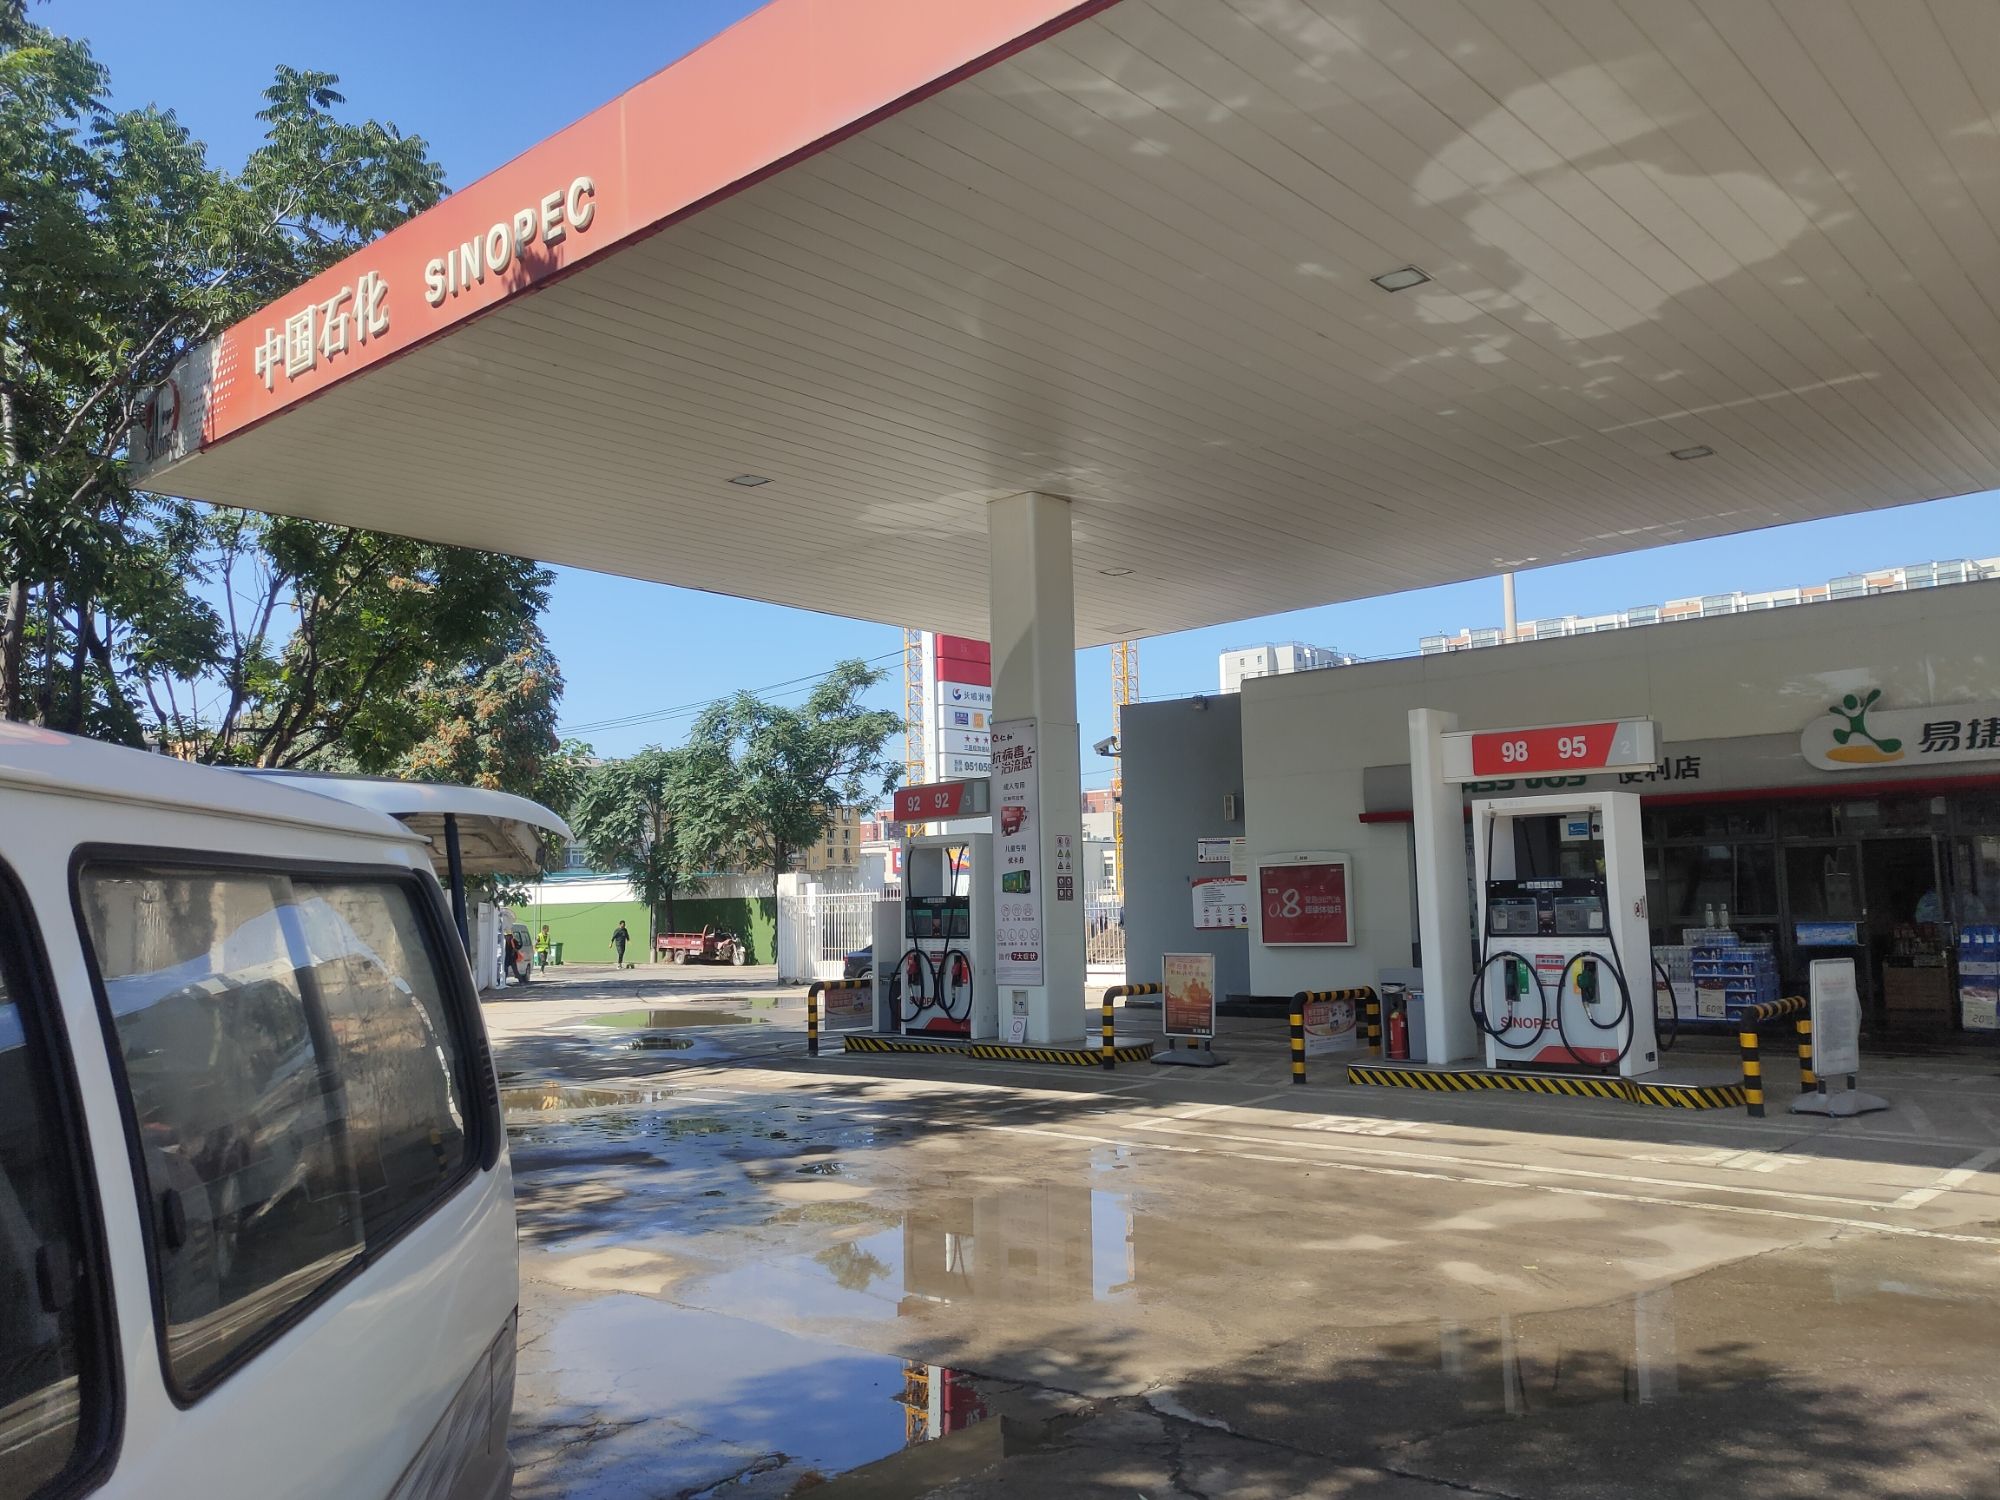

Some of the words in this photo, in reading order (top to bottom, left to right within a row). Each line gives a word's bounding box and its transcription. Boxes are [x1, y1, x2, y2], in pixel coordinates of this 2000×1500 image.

[424, 175, 596, 307] SINOPEC
[254, 270, 389, 391] 中国石化
[1918, 716, 2000, 754] 易捷
[992, 745, 1025, 764] 抗病毒
[1501, 740, 1529, 763] 98
[1557, 735, 1587, 759] 95
[1620, 740, 1632, 755] 2
[1001, 755, 1033, 775] 治流感
[907, 796, 921, 812] 92
[934, 792, 950, 809] 92
[1500, 1016, 1560, 1030] SNOPEC
